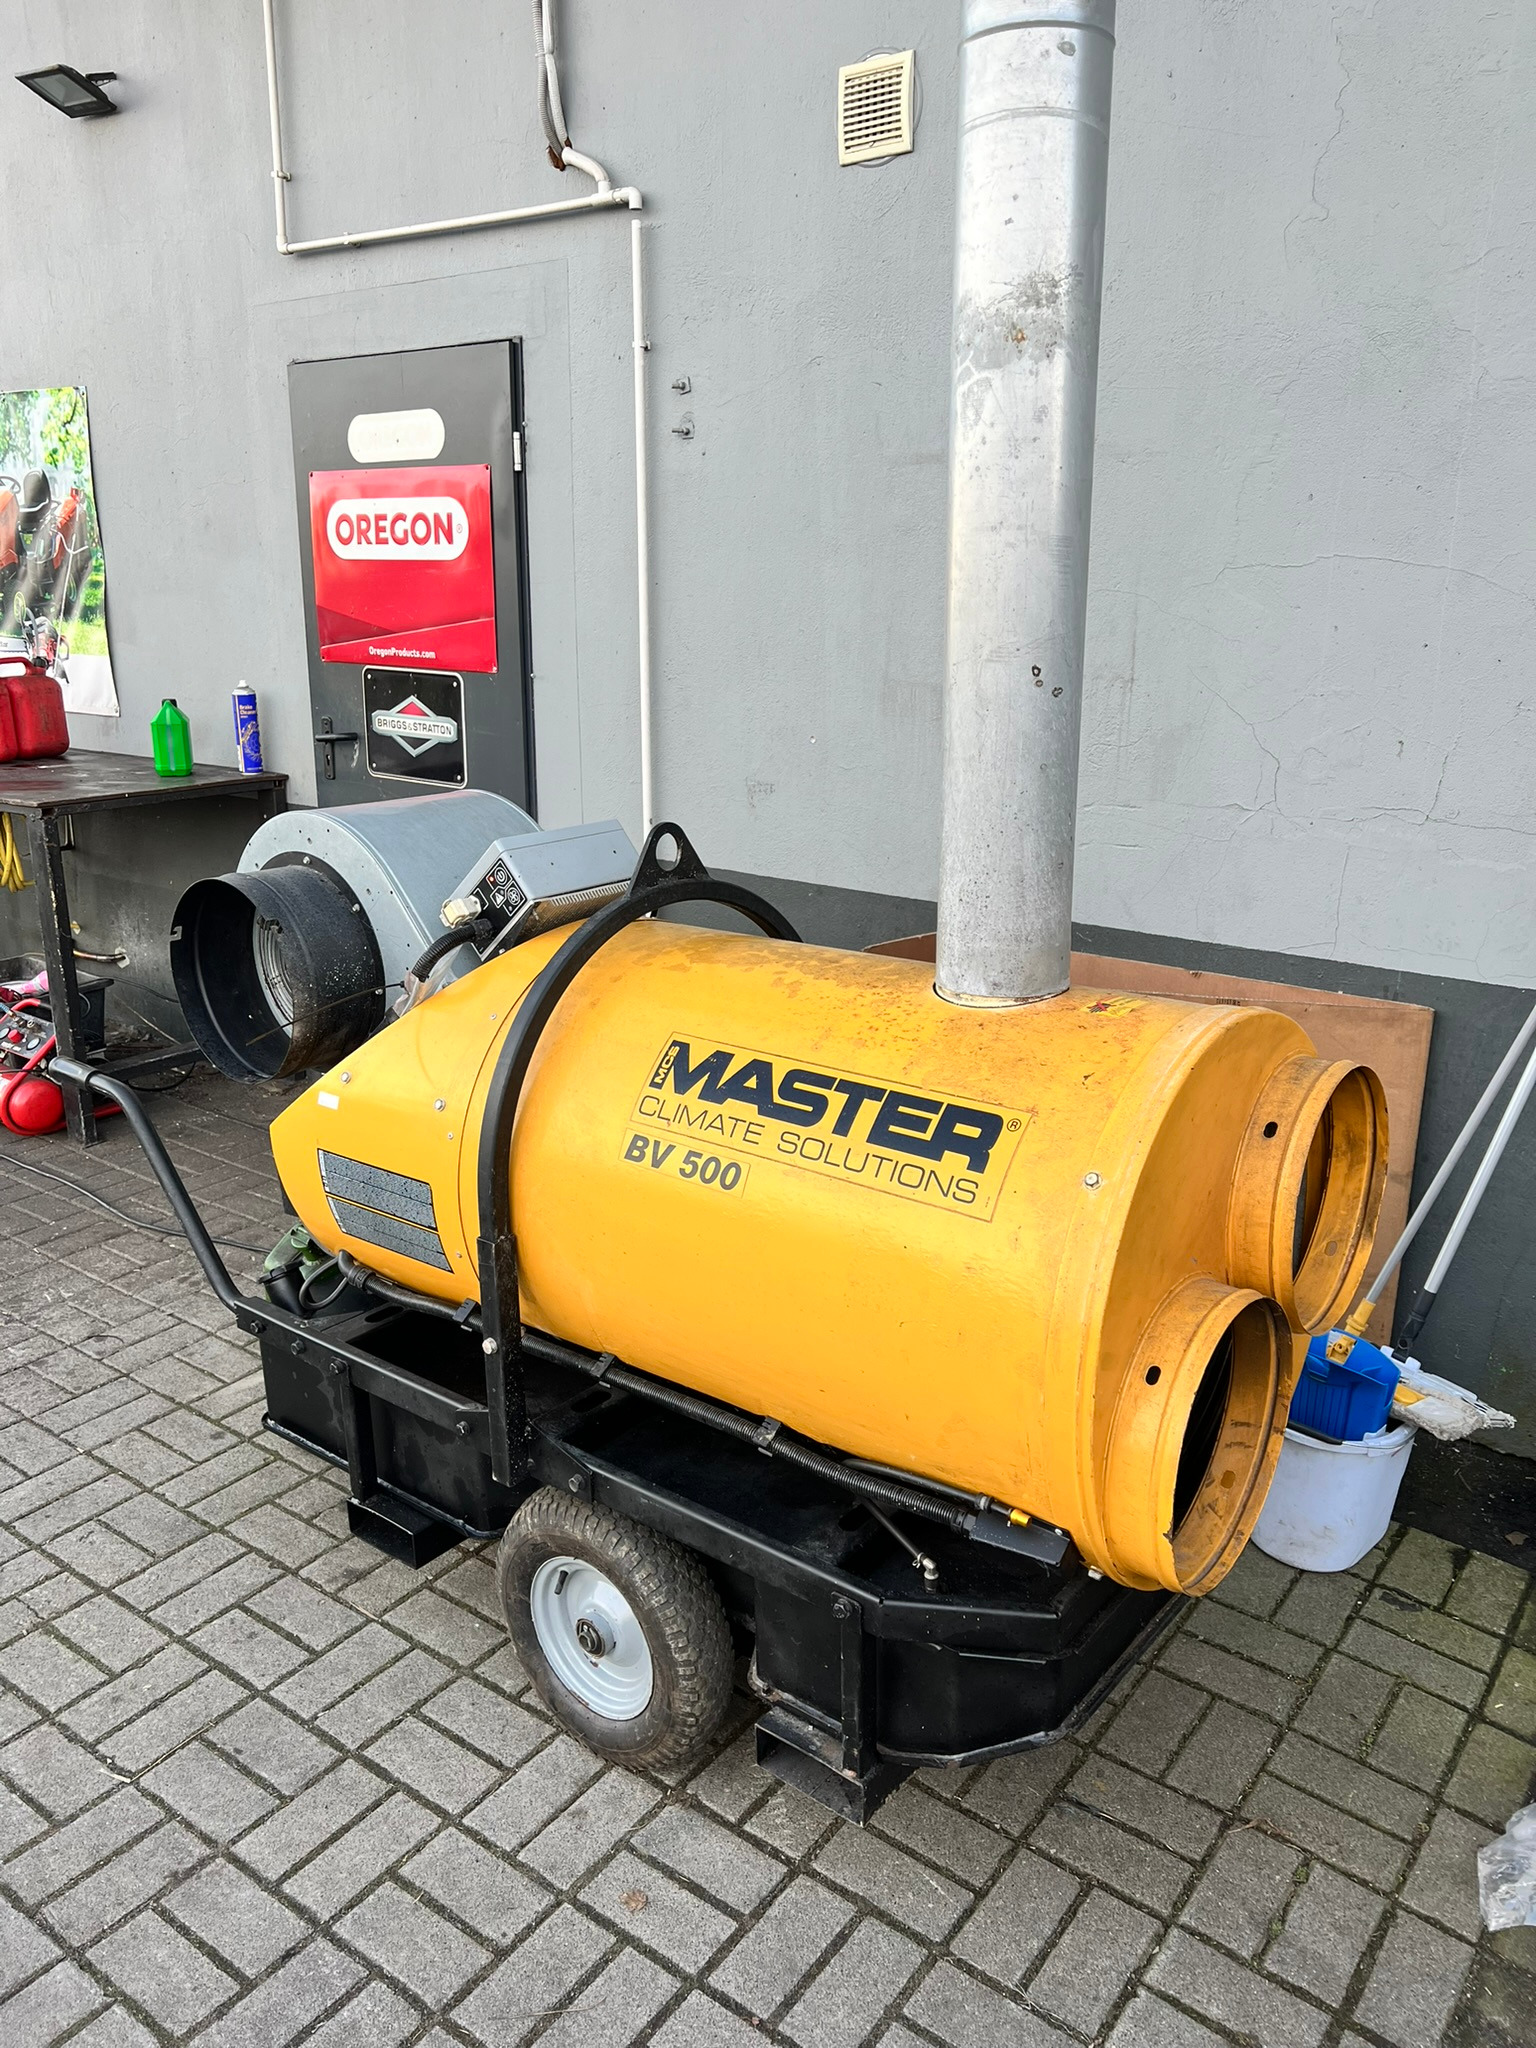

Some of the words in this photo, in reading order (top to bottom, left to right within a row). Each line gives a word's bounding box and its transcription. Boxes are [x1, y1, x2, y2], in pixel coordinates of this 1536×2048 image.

[335, 511, 454, 546] OREGON
[368, 645, 436, 659] OregonProducts.com
[652, 1044, 681, 1084] MCS
[623, 1133, 677, 1170] BV
[678, 1149, 742, 1191] 500
[638, 1094, 766, 1145] CLIMATE
[776, 1130, 980, 1204] SOLUTIONS
